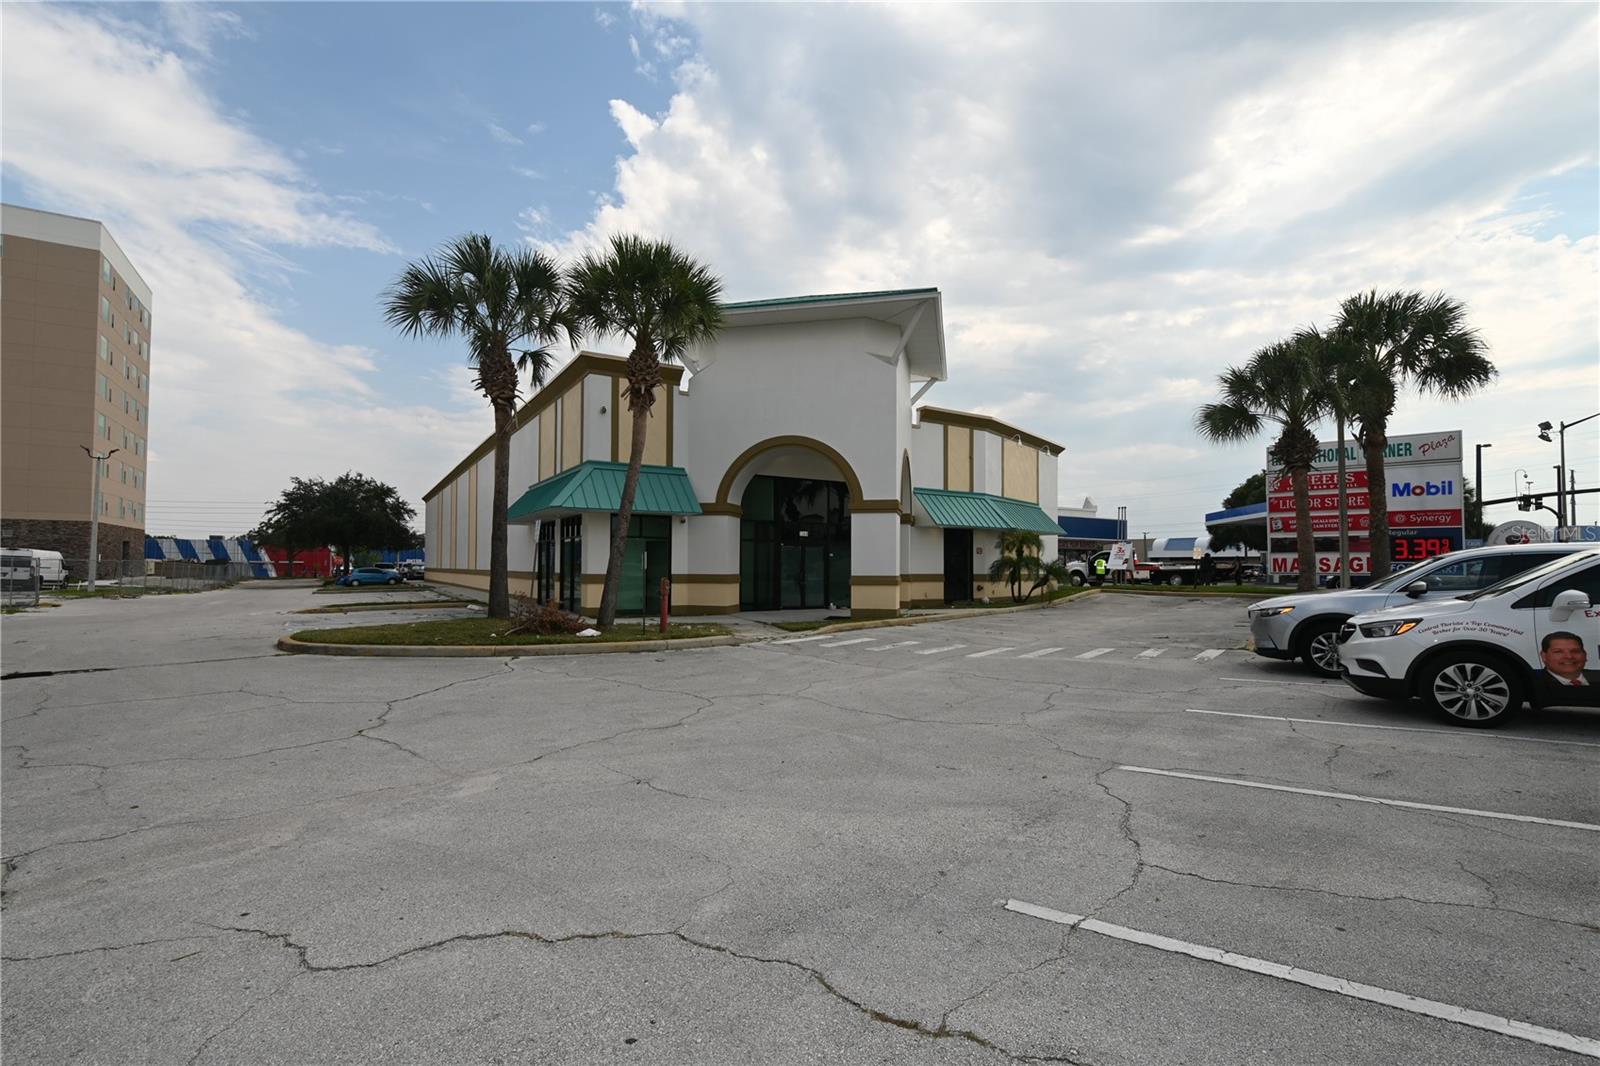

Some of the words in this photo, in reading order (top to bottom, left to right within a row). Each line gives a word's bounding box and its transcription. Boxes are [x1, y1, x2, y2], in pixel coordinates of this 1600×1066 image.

[1418, 434, 1456, 456] Plaza
[1391, 480, 1453, 497] Mobil
[1279, 498, 1321, 509] LIR
[1324, 496, 1365, 507] STRE
[1409, 514, 1452, 523] Synergy
[1272, 556, 1374, 573] MASAG
[1418, 624, 1439, 634] Central
[1483, 621, 1524, 635] Commercial
